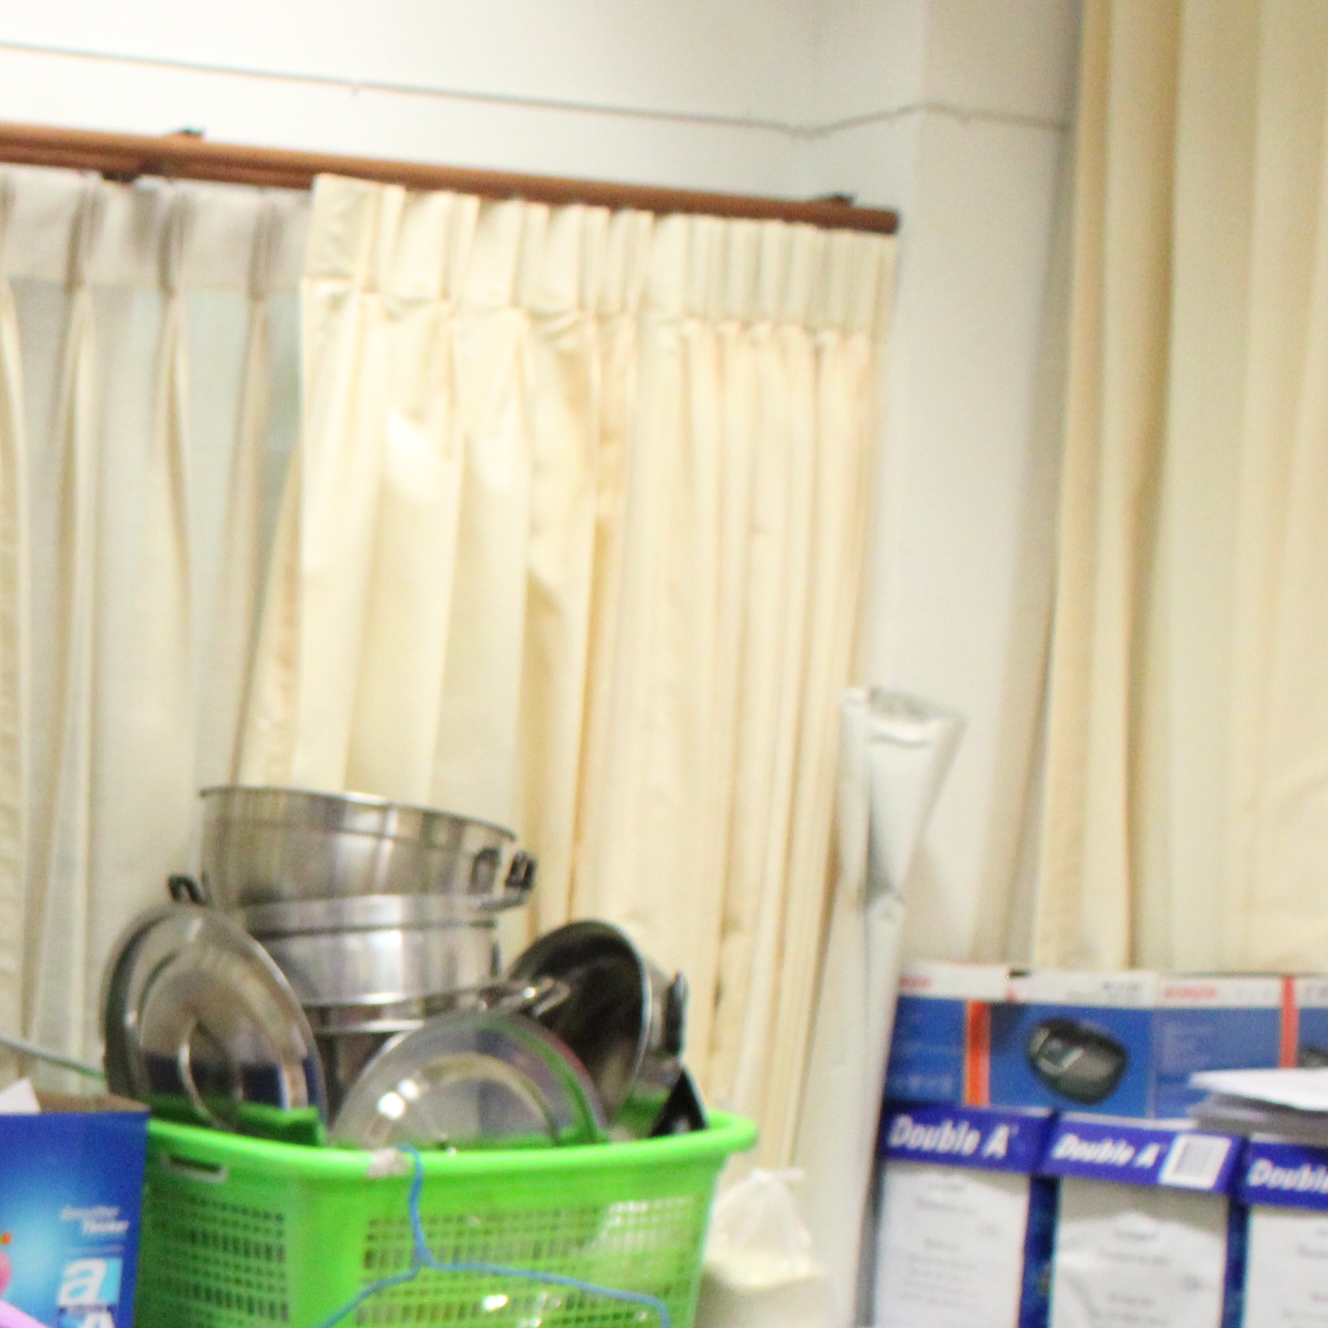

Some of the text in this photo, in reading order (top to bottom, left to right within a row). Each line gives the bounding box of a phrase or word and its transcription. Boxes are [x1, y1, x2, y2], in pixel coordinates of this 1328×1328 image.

[887, 1114, 1010, 1159] Double A
[1051, 1133, 1161, 1169] Double A
